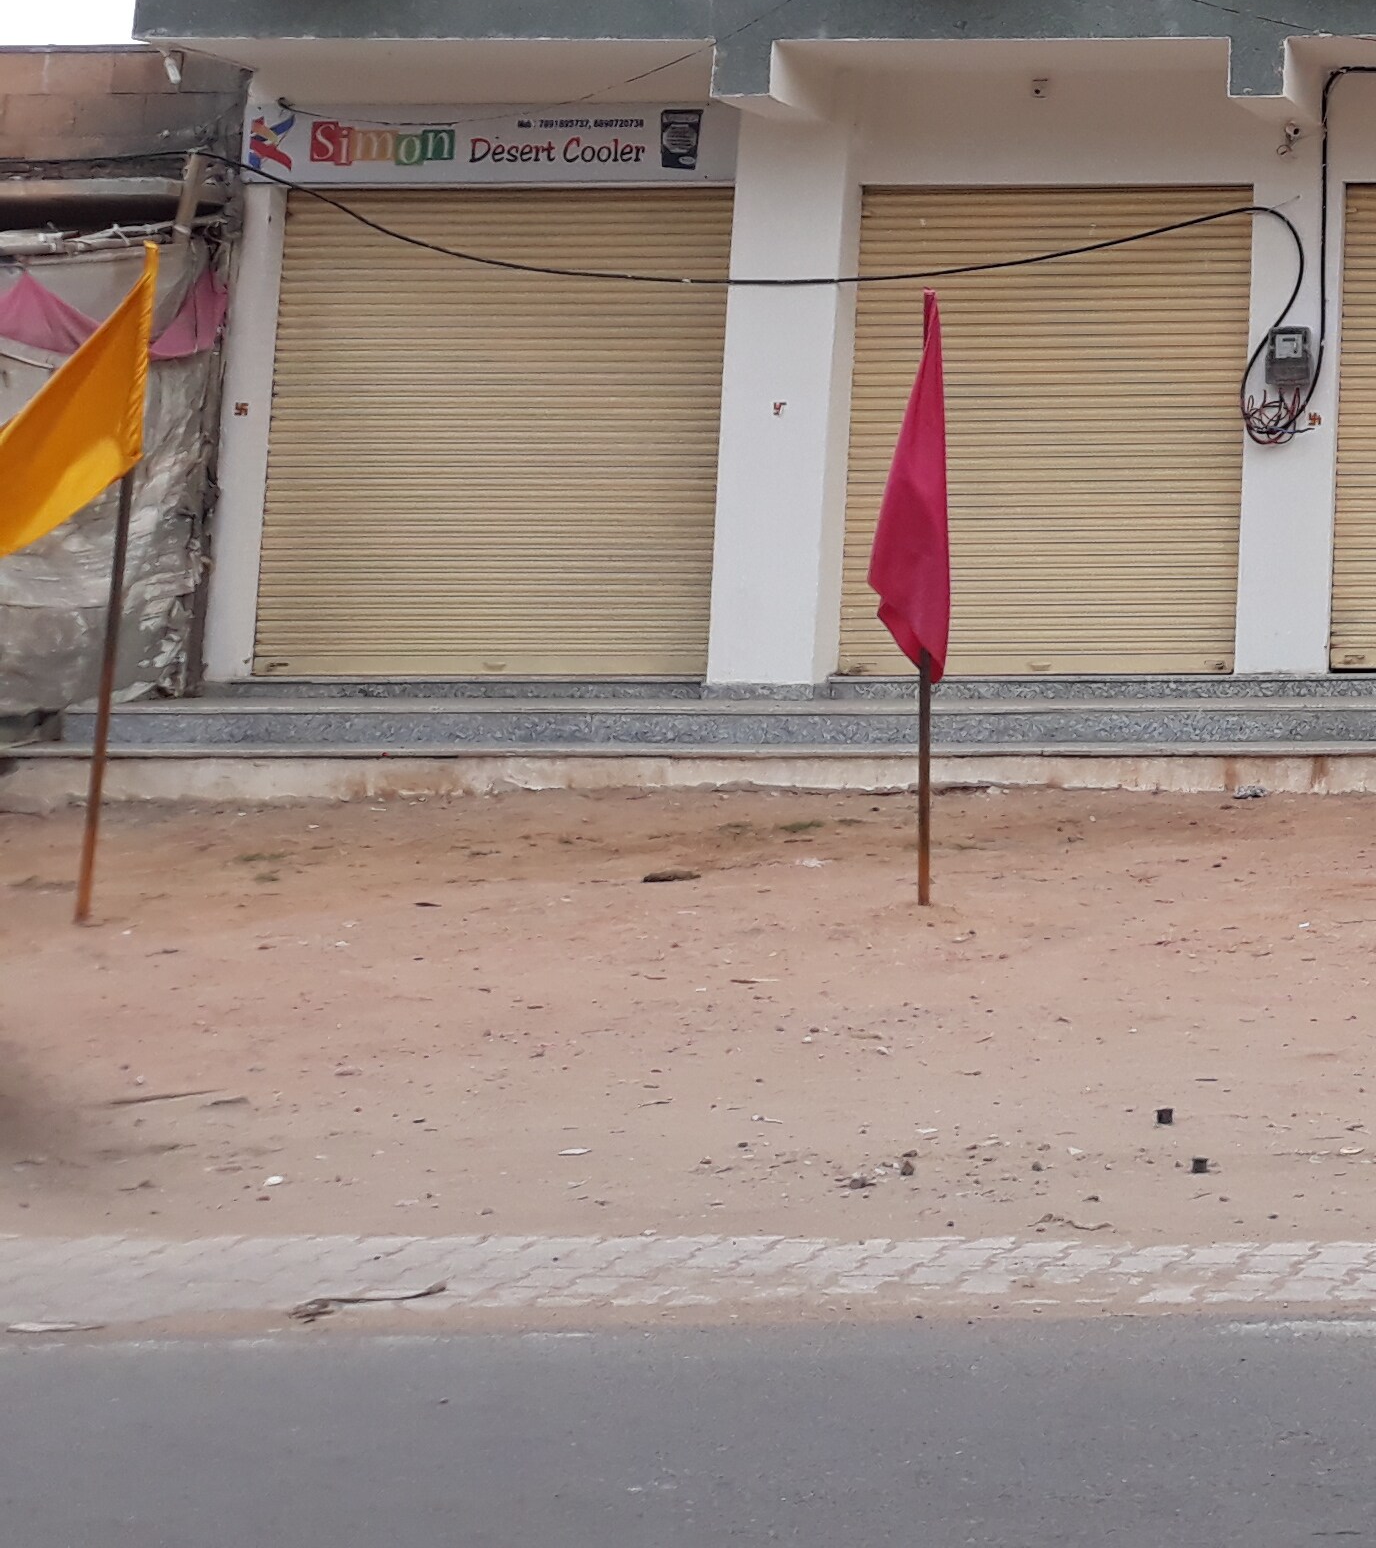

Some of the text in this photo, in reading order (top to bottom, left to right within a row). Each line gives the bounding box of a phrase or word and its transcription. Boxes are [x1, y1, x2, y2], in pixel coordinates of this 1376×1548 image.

[311, 122, 454, 165] Simon
[468, 138, 556, 163] Desert
[563, 136, 646, 163] Cooler
